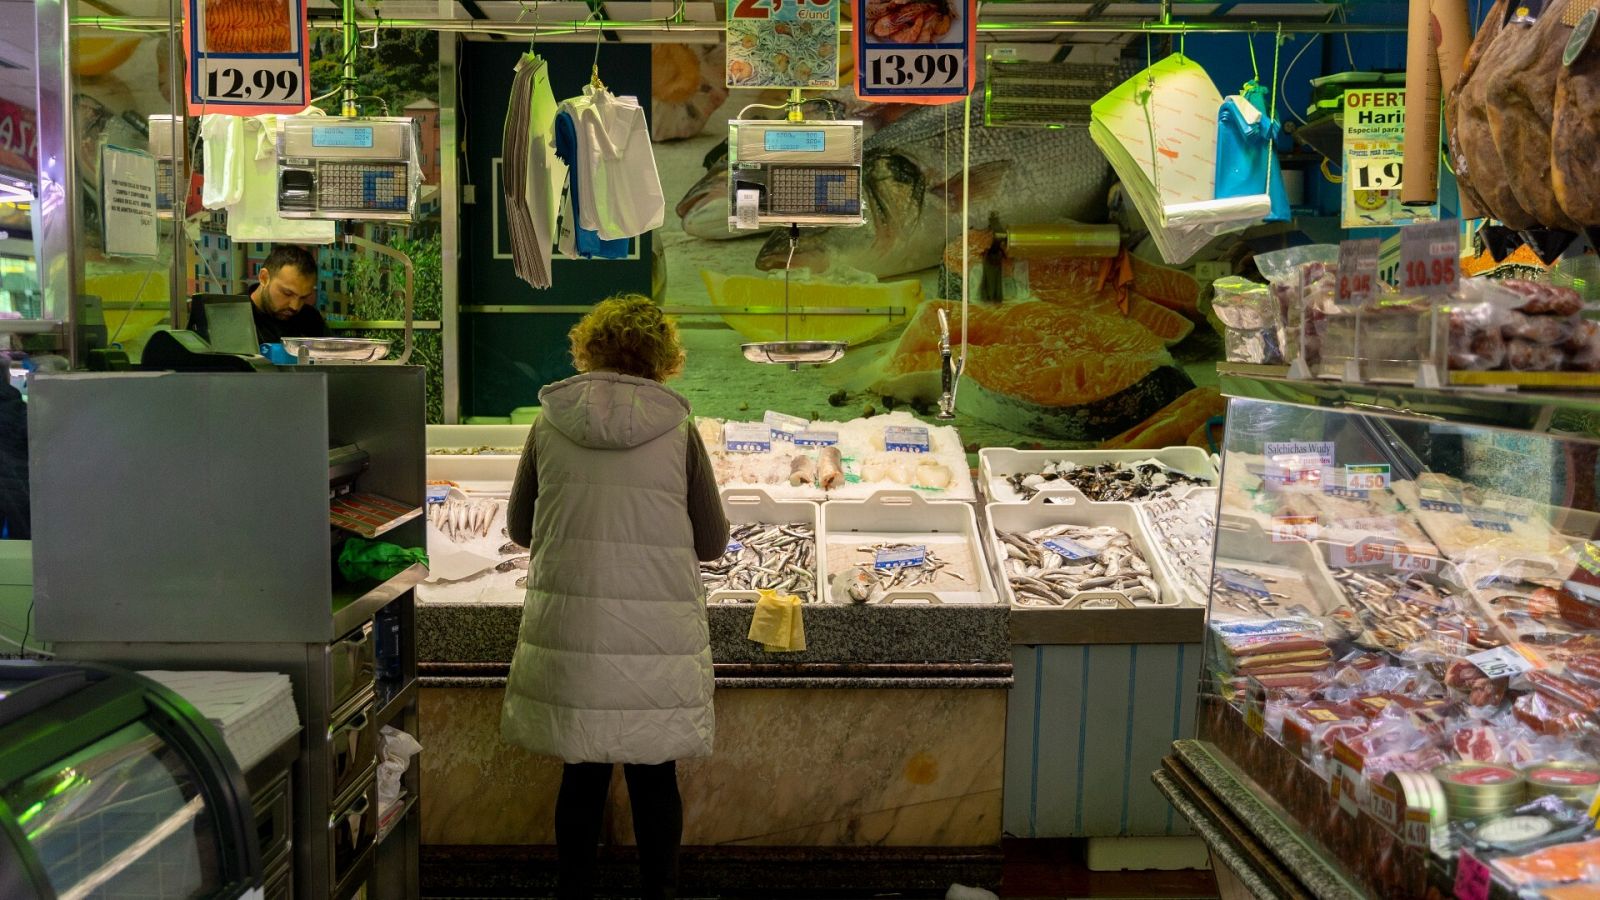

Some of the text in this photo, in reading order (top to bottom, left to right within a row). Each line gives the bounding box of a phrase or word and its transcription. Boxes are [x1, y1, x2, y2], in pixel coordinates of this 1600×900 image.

[798, 9, 830, 20] €/und
[869, 54, 958, 85] 13,99
[208, 68, 298, 100] 12,99
[1347, 92, 1406, 108] OFERT
[1358, 110, 1404, 124] Hari
[1358, 162, 1402, 188] 1,9
[1406, 256, 1455, 289] 10.95
[1268, 443, 1331, 456] Salchichas Wudy
[1350, 475, 1384, 488] 4.50
[1398, 553, 1431, 570] 7.50
[1373, 794, 1392, 820] 7.50
